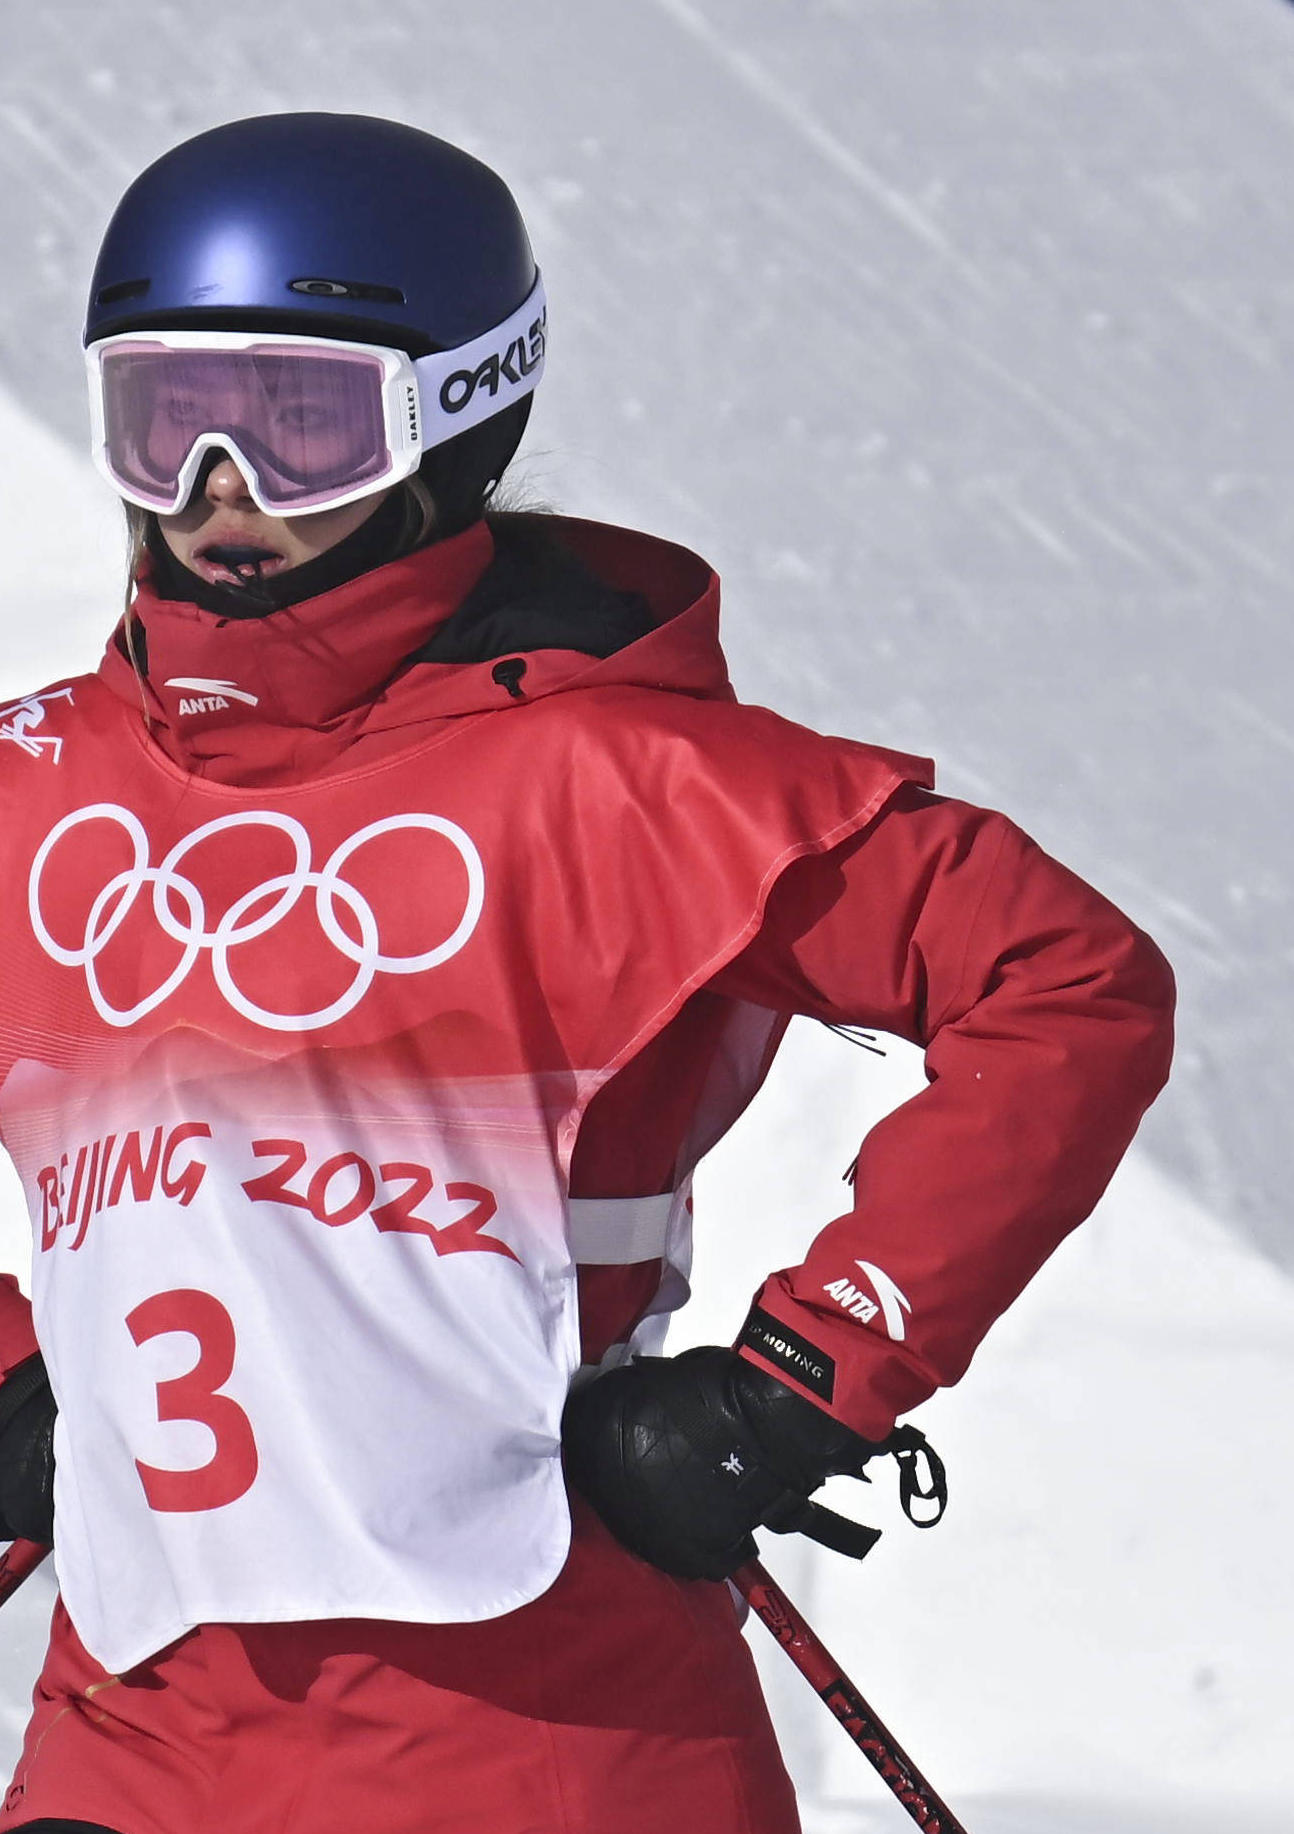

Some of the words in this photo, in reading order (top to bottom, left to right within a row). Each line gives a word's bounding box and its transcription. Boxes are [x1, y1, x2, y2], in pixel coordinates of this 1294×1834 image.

[406, 385, 418, 441] OAKLEY
[178, 694, 230, 717] ANTA
[240, 1138, 524, 1268] 2022
[823, 1278, 879, 1325] ANTA
[762, 1332, 825, 1379] MOVING
[124, 1288, 259, 1513] 3
